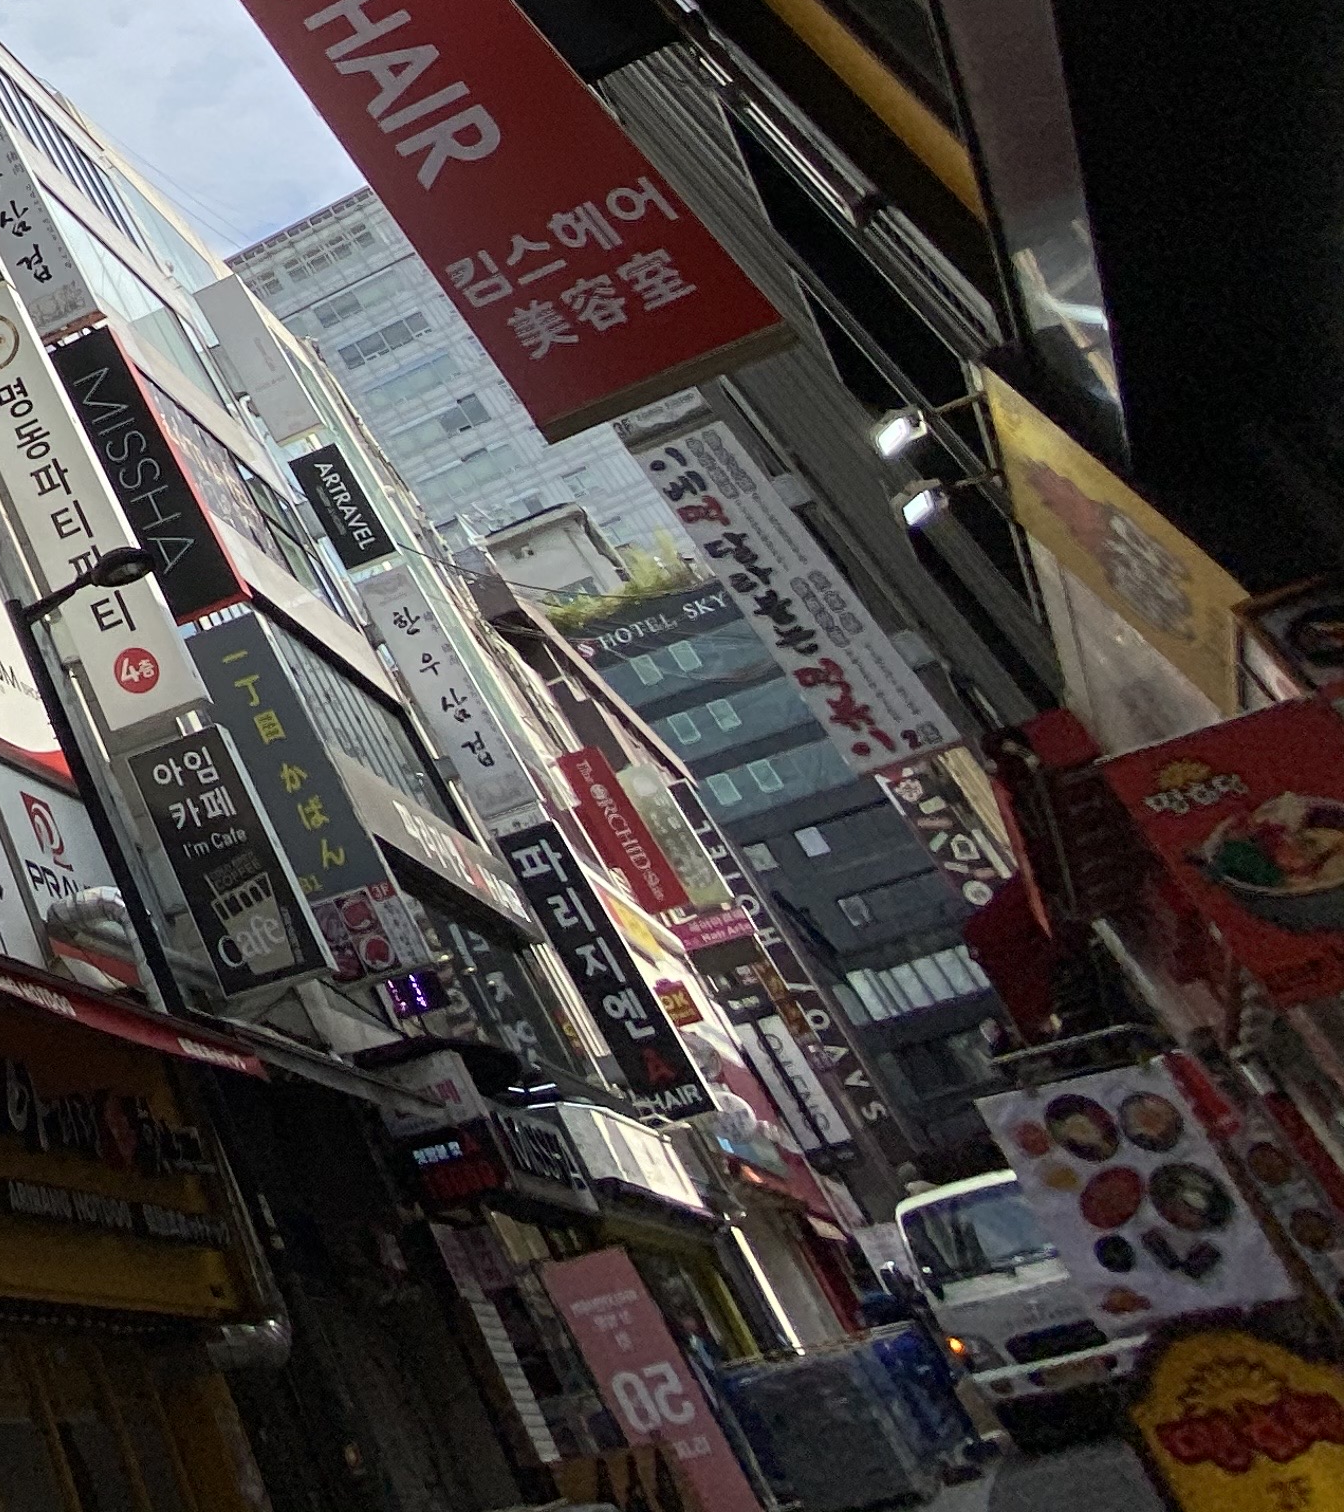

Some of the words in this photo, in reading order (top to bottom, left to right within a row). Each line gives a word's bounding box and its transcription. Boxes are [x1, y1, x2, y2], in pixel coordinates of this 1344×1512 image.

[443, 175, 682, 311] 킴스헤어
[506, 246, 698, 361] 美容室
[73, 366, 196, 576] MISSHA
[314, 460, 377, 552] ARTRAVEL
[597, 615, 680, 655] HOTEL
[681, 591, 728, 620] SKY
[152, 745, 220, 788] 아임
[168, 785, 238, 831] 카페
[182, 838, 211, 860] I'm
[210, 826, 248, 851] Cafe
[589, 783, 653, 872] ORCHID
[217, 914, 286, 969] Cafe
[511, 838, 656, 1041] 파리지엔
[649, 1084, 705, 1113] HAIR
